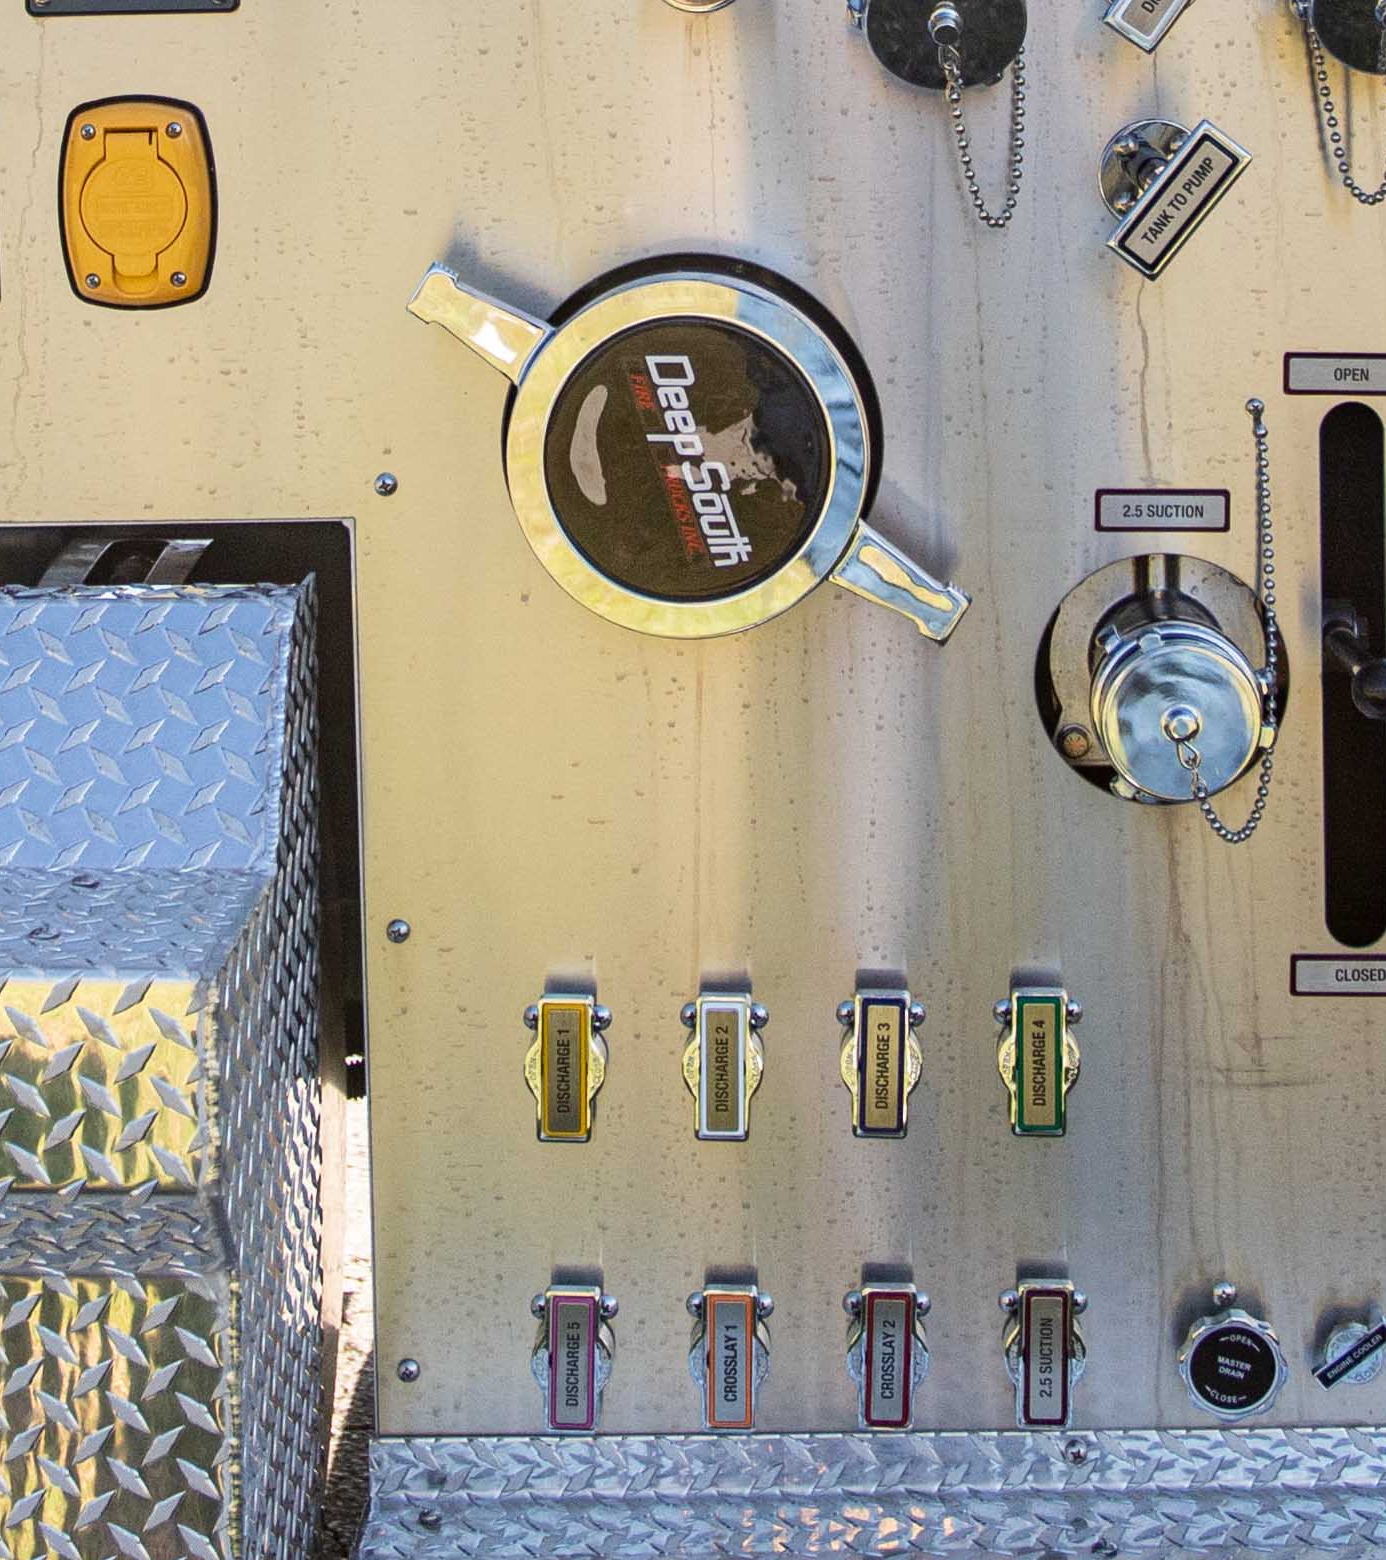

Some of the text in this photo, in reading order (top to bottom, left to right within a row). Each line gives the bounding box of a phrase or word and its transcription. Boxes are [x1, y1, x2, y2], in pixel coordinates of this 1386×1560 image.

[1140, 157, 1216, 247] TANK TO PUMP
[630, 373, 657, 409] FIRE
[1333, 367, 1370, 382] OPEN
[1123, 504, 1204, 519] 2.5 SUCTION
[1335, 968, 1386, 982] CLOSED
[557, 1036, 571, 1113] DISCHARGE
[715, 1025, 729, 1113] DISCHARGE 2
[875, 1022, 891, 1109] DISCHARGE 3
[1032, 1019, 1046, 1106] DISCHARGE 4
[565, 1321, 581, 1407] DISCHARGE 5
[724, 1334, 738, 1403] CROSSLAY
[881, 1319, 896, 1400] CROSSLAY 2
[1039, 1317, 1053, 1398] 2.5 SUCTION
[1217, 1355, 1252, 1371] MASTER
[1229, 1334, 1253, 1346] OPEN
[1326, 1334, 1383, 1379] ENGINE COOLER
[1210, 1389, 1238, 1403] CLOSE
[1218, 1366, 1245, 1379] DRAIN
